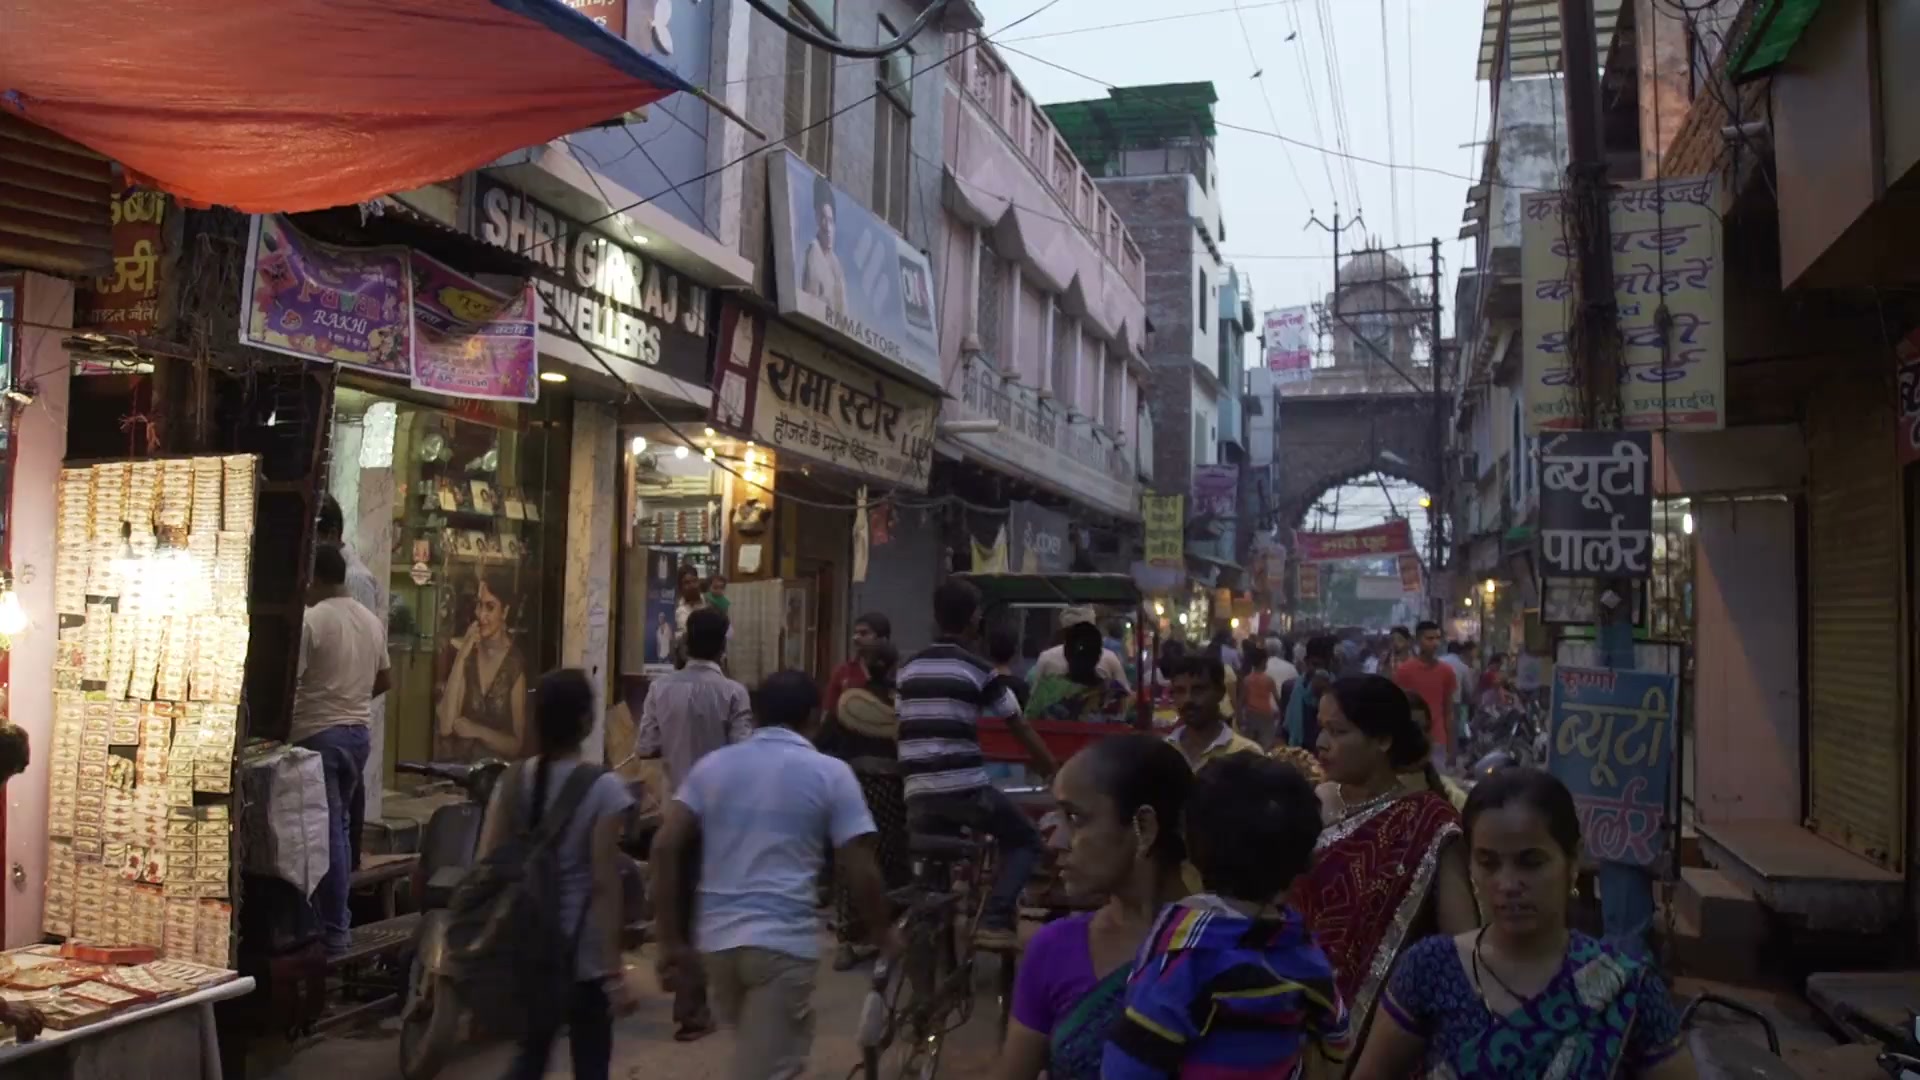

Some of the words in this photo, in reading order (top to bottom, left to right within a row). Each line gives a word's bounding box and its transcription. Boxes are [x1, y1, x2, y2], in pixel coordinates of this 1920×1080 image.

[482, 188, 567, 277] SHRI
[574, 231, 678, 324] GIRRAJ
[682, 284, 708, 337] JI
[313, 309, 367, 335] RAKHI
[530, 276, 661, 365] EWELLERS
[825, 304, 864, 339] RAMA
[865, 328, 901, 356] STORE
[766, 349, 838, 418] रामा
[838, 379, 903, 443] स्टोर
[1542, 440, 1649, 514] ब्यूटी
[1541, 513, 1650, 573] पार्लर
[1556, 686, 1670, 788] ब्यूटी
